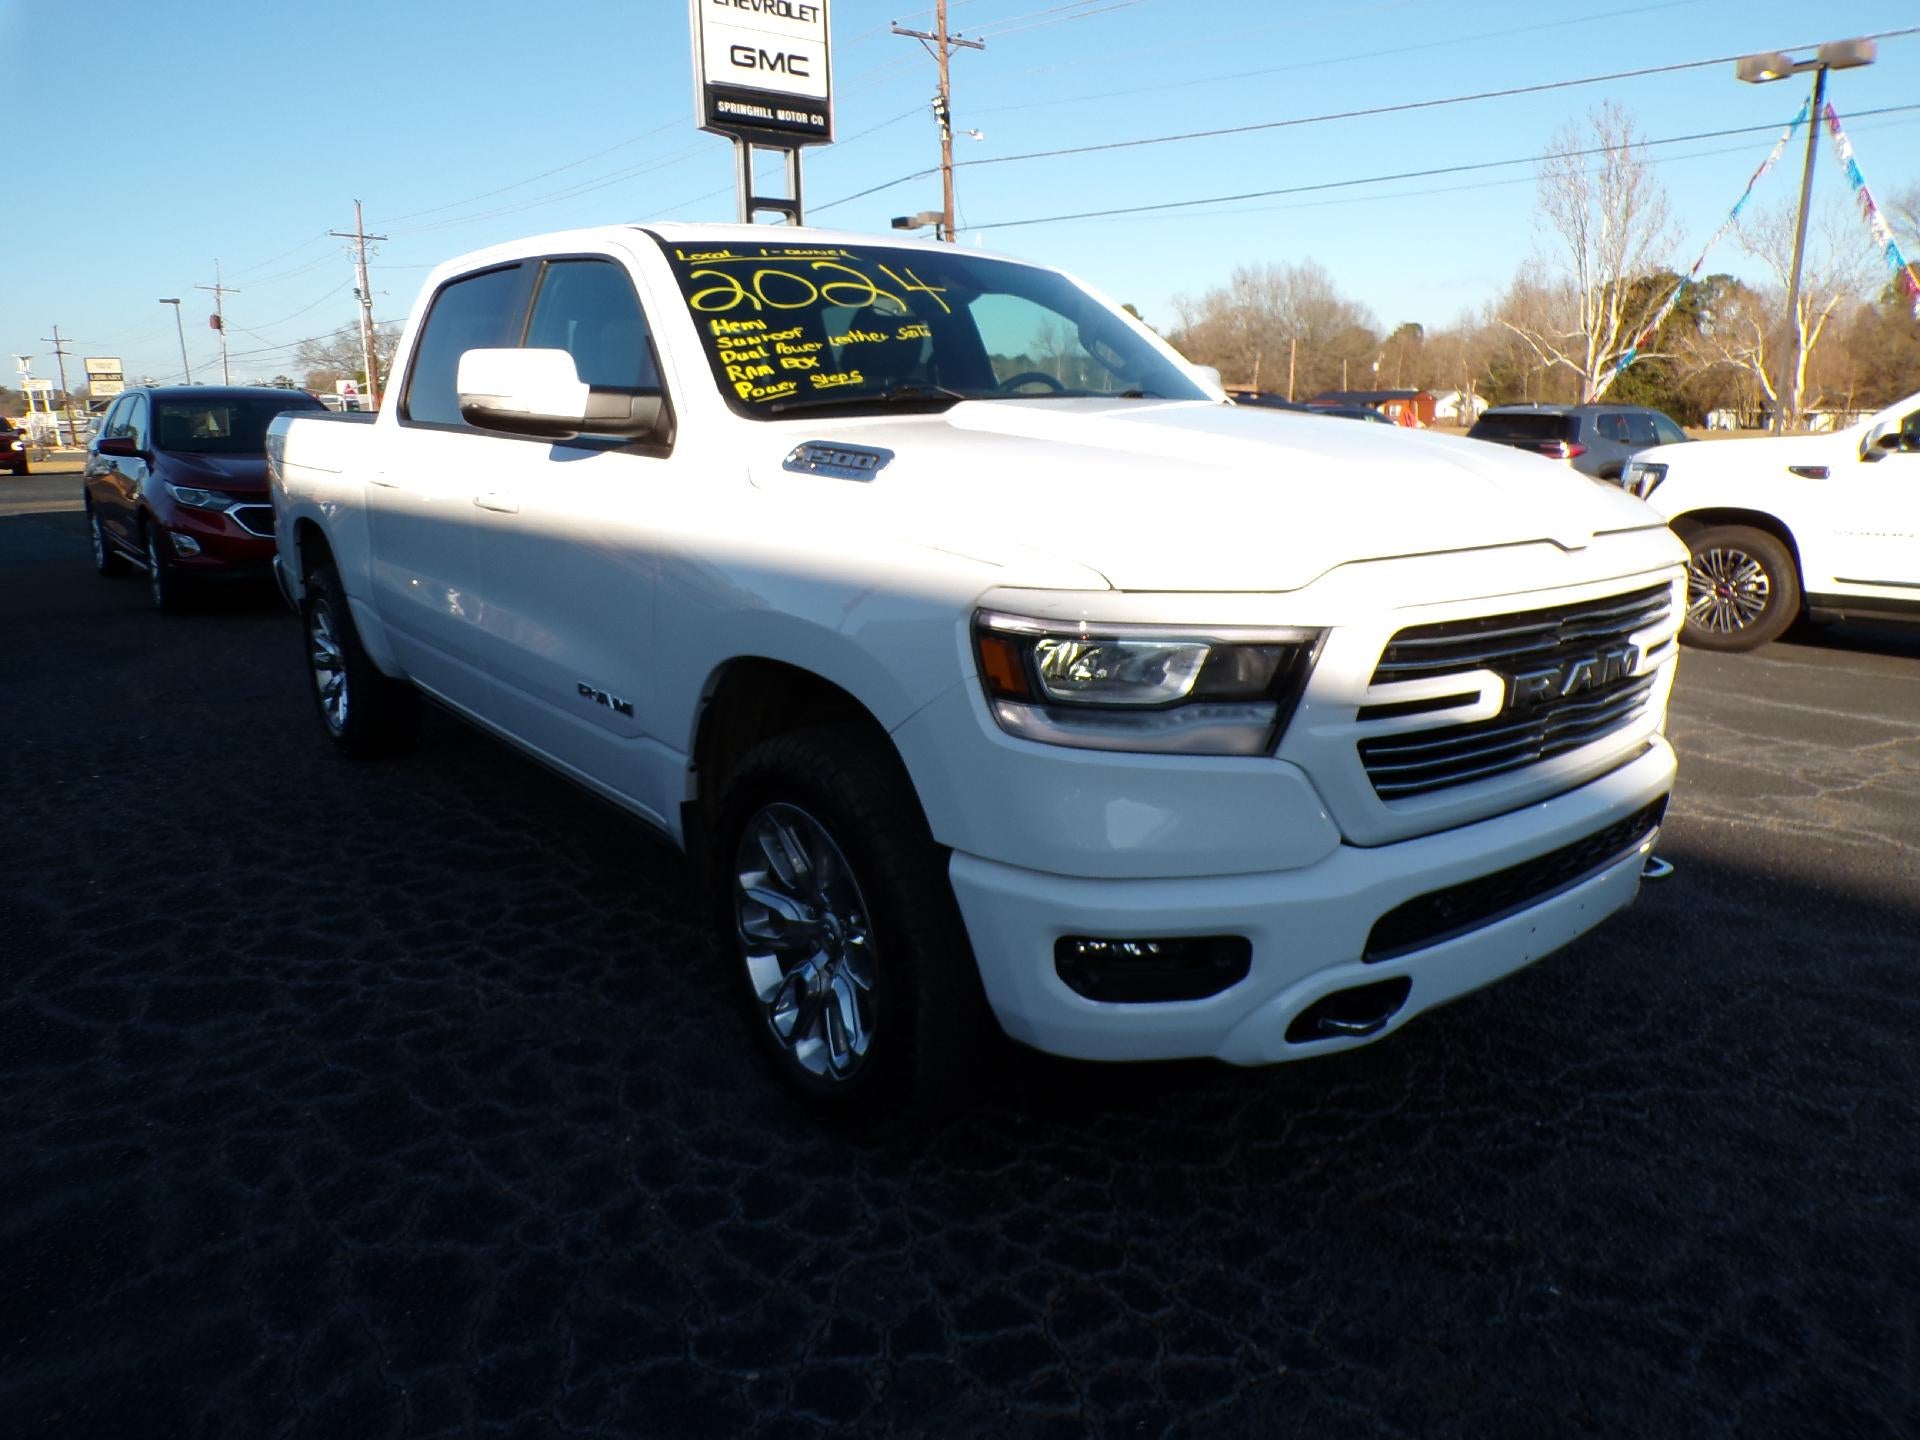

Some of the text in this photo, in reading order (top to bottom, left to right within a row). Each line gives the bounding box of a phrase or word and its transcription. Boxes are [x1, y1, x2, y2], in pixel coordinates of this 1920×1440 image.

[730, 44, 810, 77] GMC
[717, 100, 774, 119] SPRINGHILL
[776, 109, 808, 124] MOTOR
[690, 261, 951, 313] 2024
[711, 319, 767, 336] Hemi
[720, 346, 770, 364] Dual
[775, 342, 823, 355] Power
[1508, 645, 1639, 710] RAM
